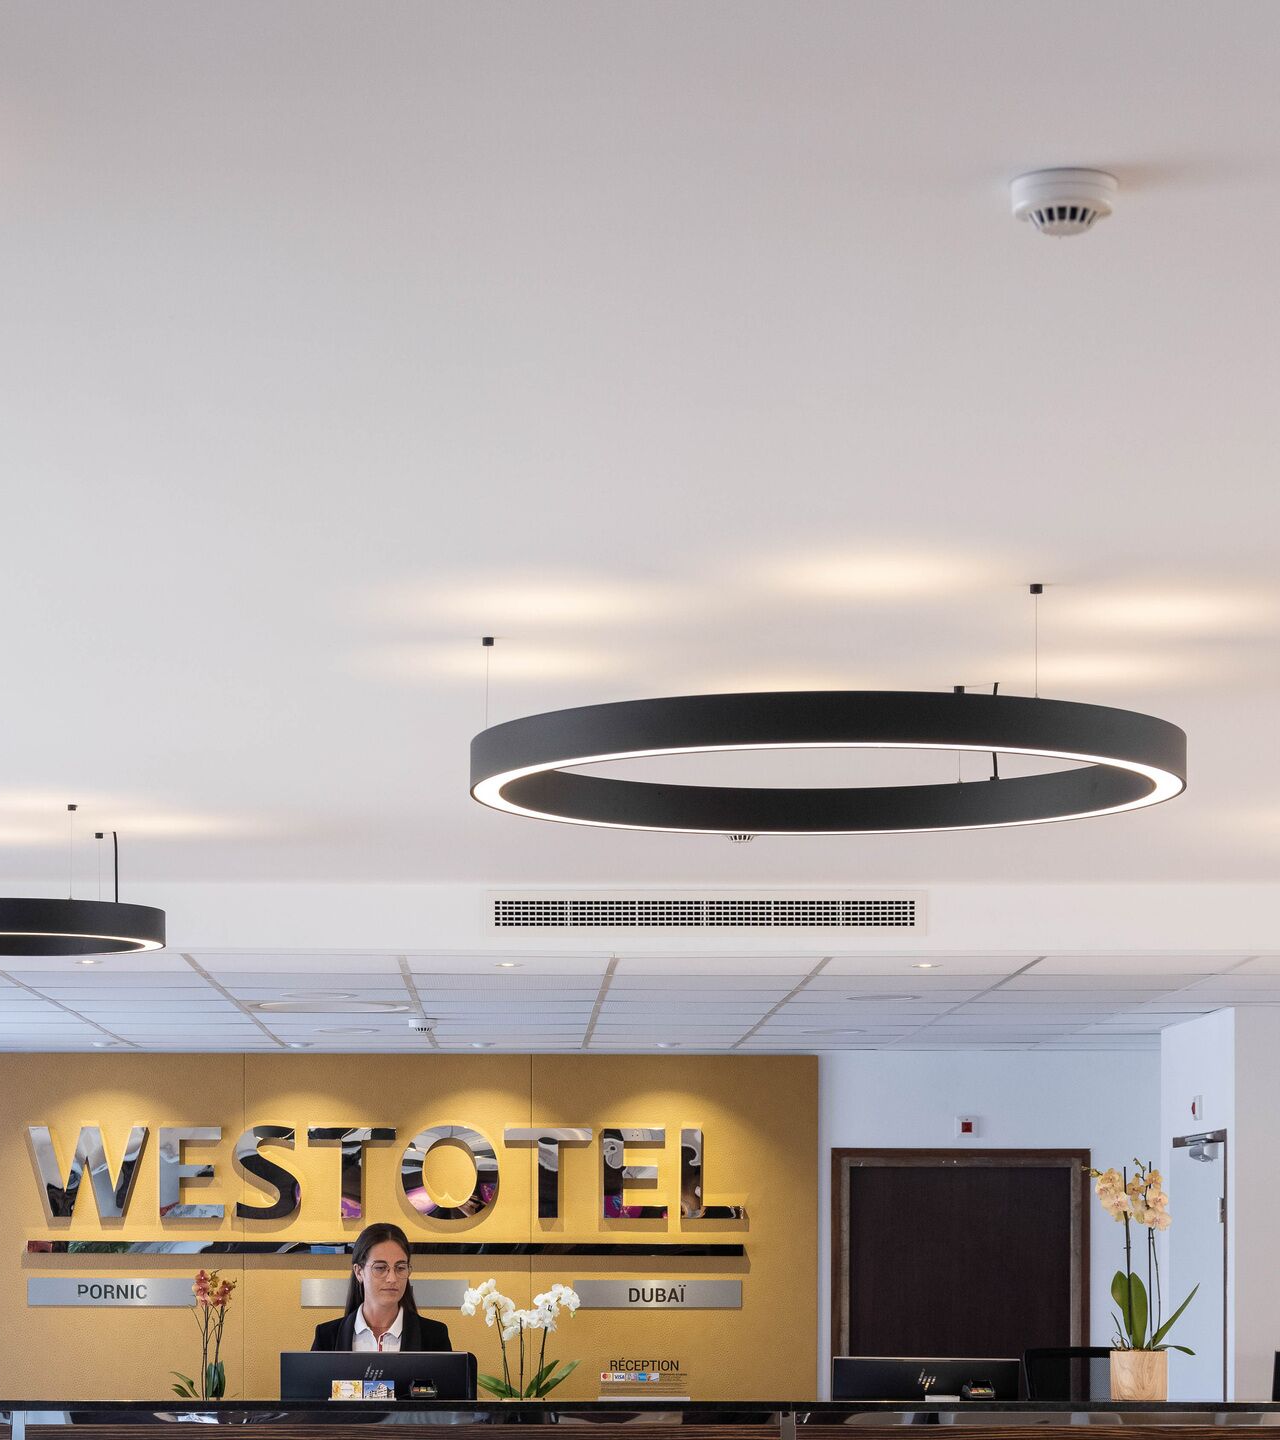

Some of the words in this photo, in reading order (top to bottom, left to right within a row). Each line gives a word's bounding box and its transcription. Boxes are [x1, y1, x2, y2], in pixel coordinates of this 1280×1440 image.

[27, 1125, 745, 1220] WESTOTEL
[77, 1284, 148, 1300] PORNIC
[628, 1284, 687, 1303] DUBAÏ
[609, 1357, 679, 1371] RÉCEPTION
